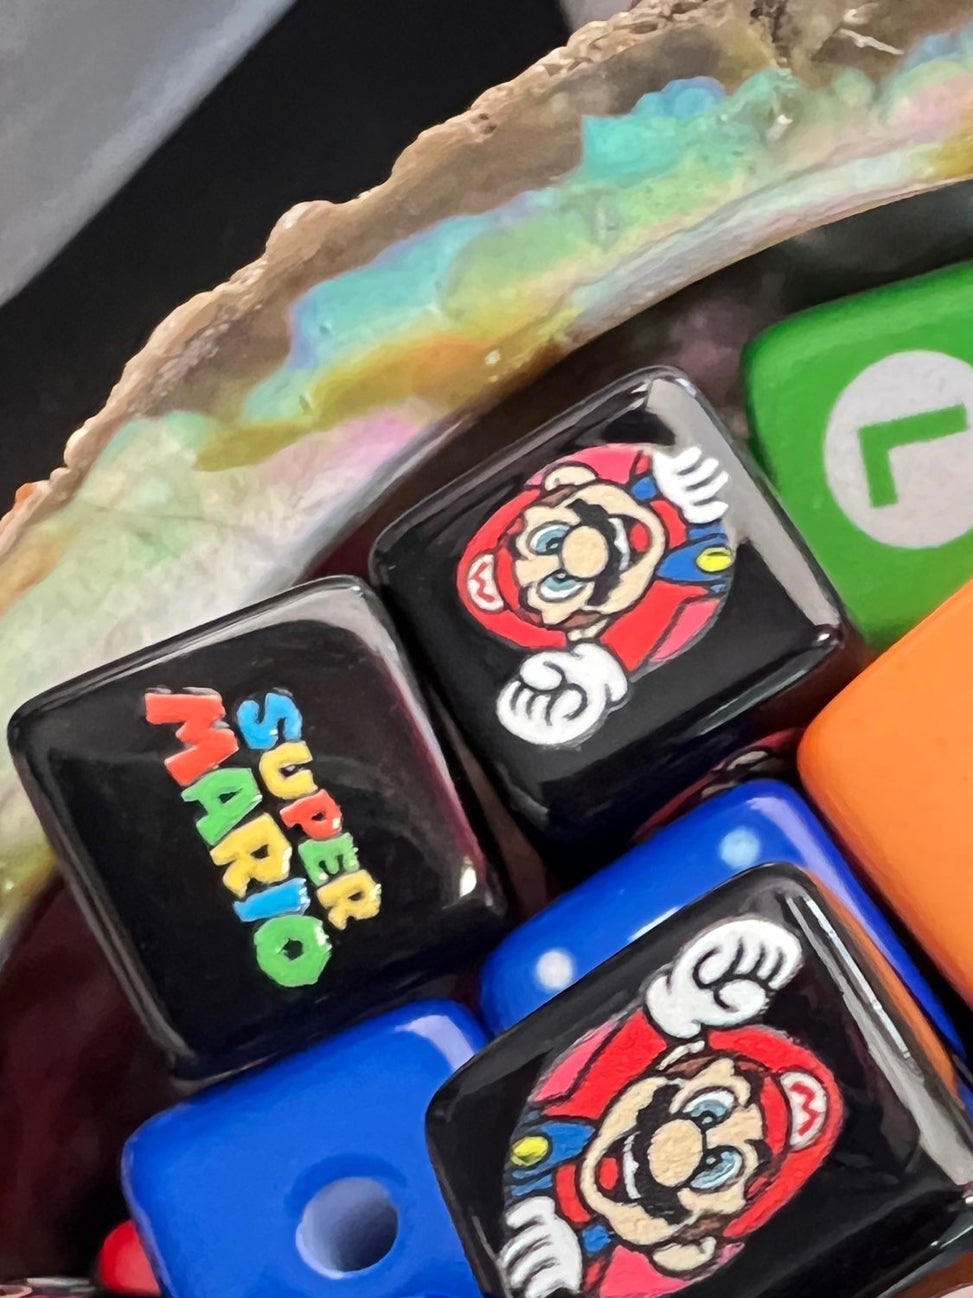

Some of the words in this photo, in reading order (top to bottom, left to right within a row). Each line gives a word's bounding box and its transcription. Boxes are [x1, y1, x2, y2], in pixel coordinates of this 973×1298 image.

[857, 404, 970, 508] L
[144, 688, 331, 988] MARIO
[237, 687, 382, 929] SUPER
